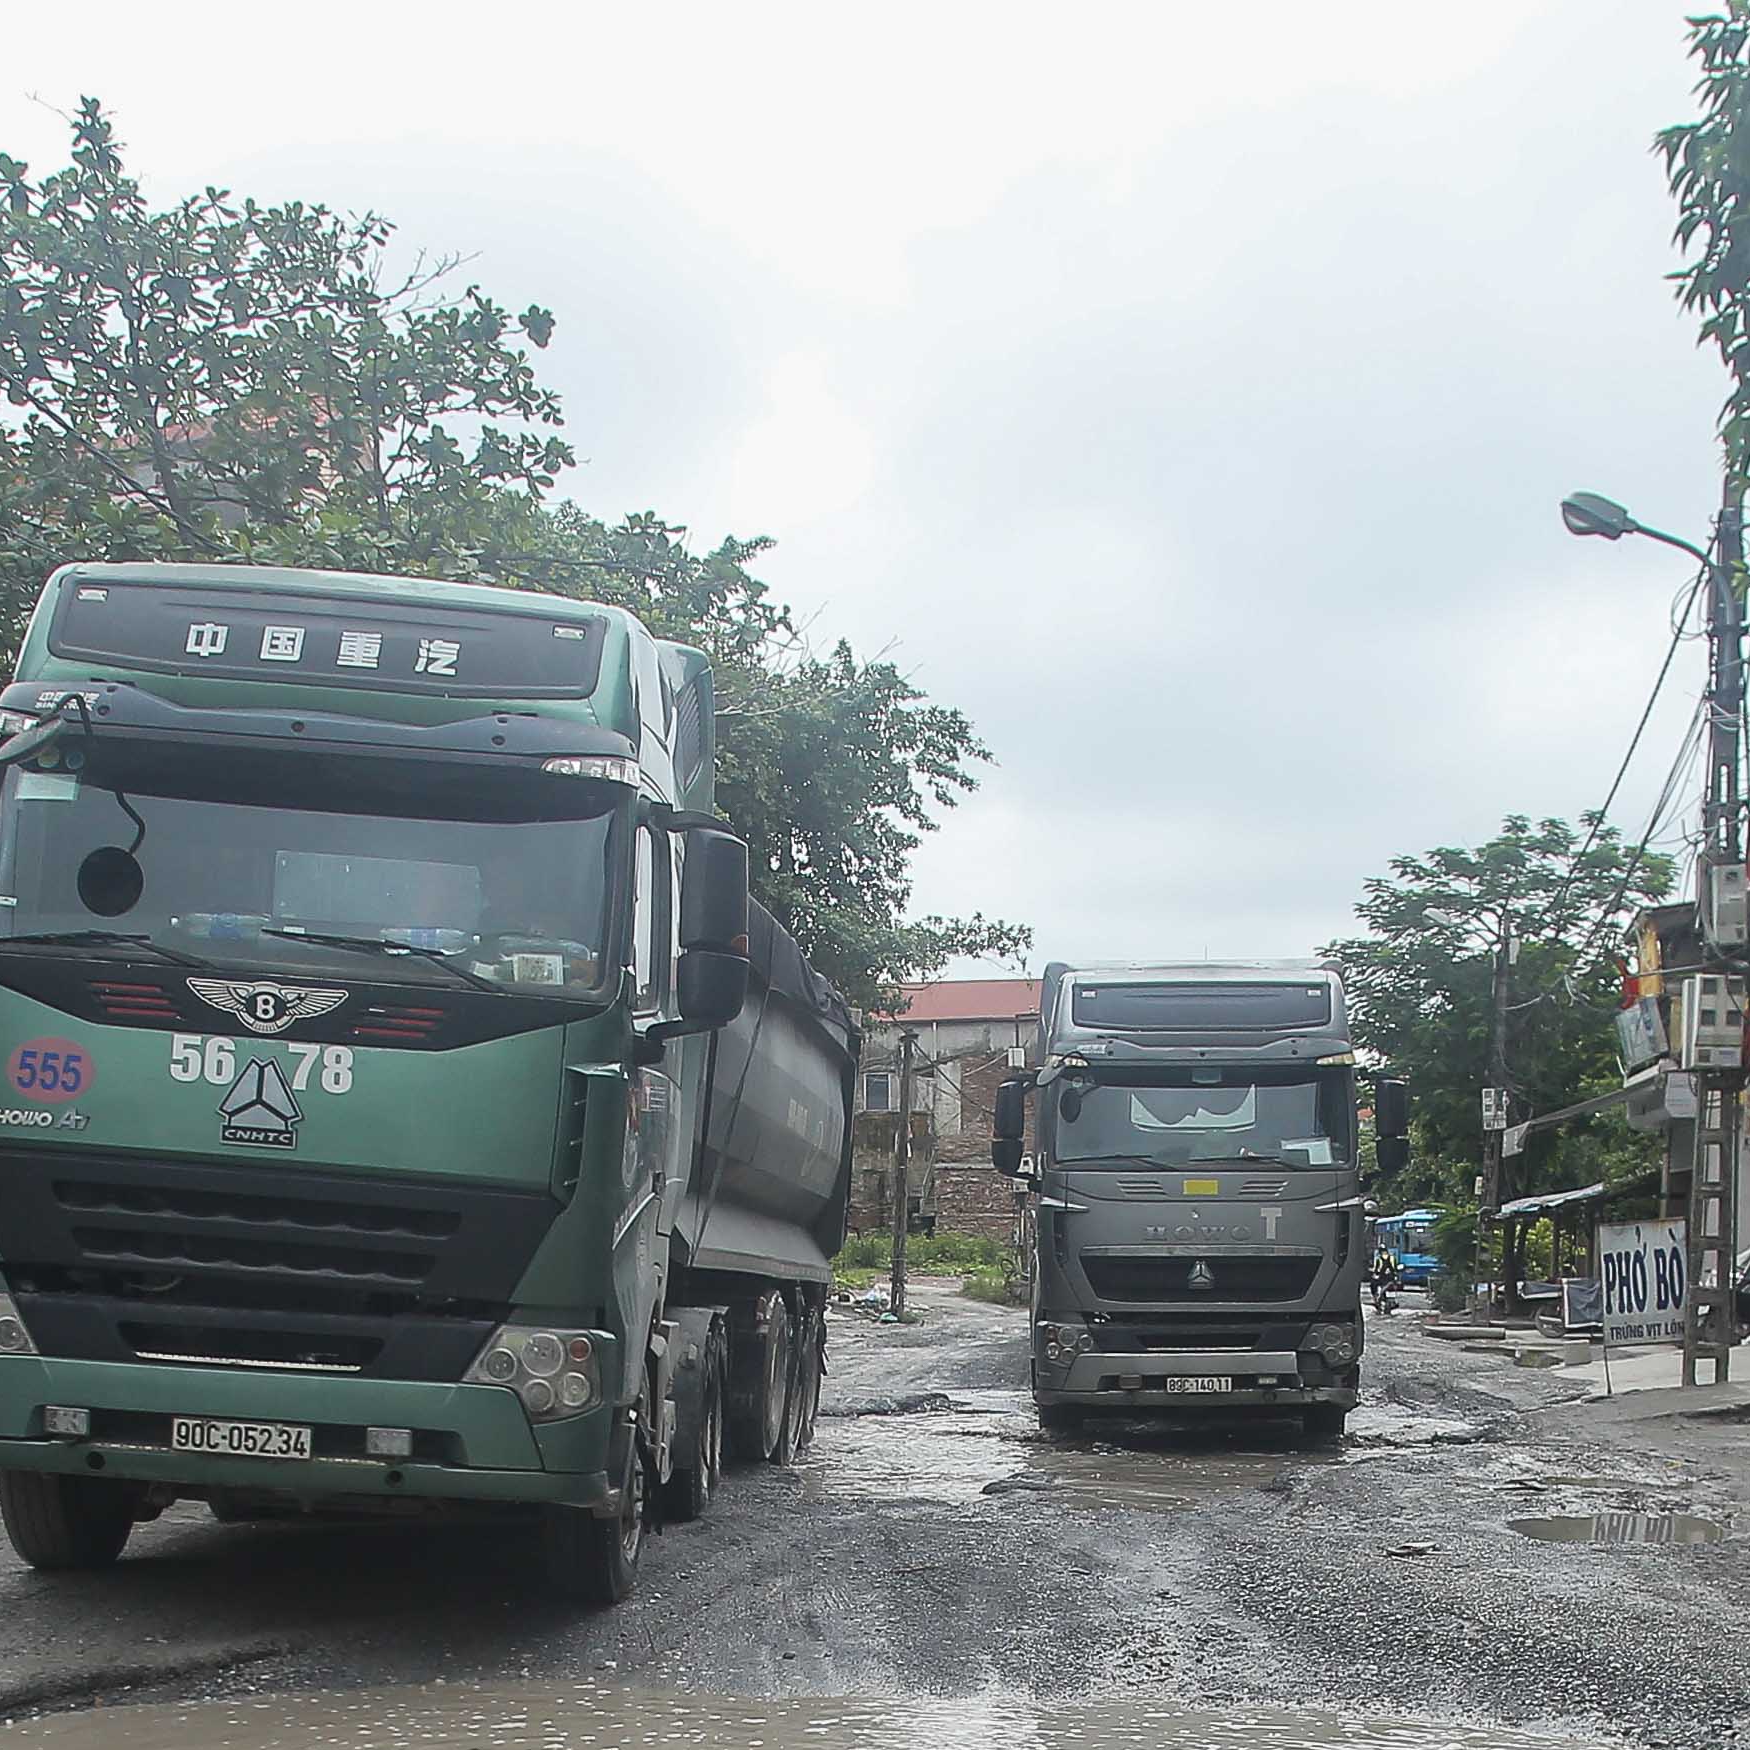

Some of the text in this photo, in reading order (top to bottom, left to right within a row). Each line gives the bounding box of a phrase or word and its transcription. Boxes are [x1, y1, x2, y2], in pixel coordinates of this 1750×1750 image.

[184, 621, 462, 677] 中国重汽
[255, 994, 276, 1020] B
[16, 1049, 82, 1093] 555
[169, 1032, 355, 1095] 56 78
[224, 1129, 292, 1144] CNHTC
[1260, 1207, 1283, 1240] T
[1603, 1225, 1684, 1315] PHỞ BÒ
[175, 1421, 308, 1457] 90C-052.34
